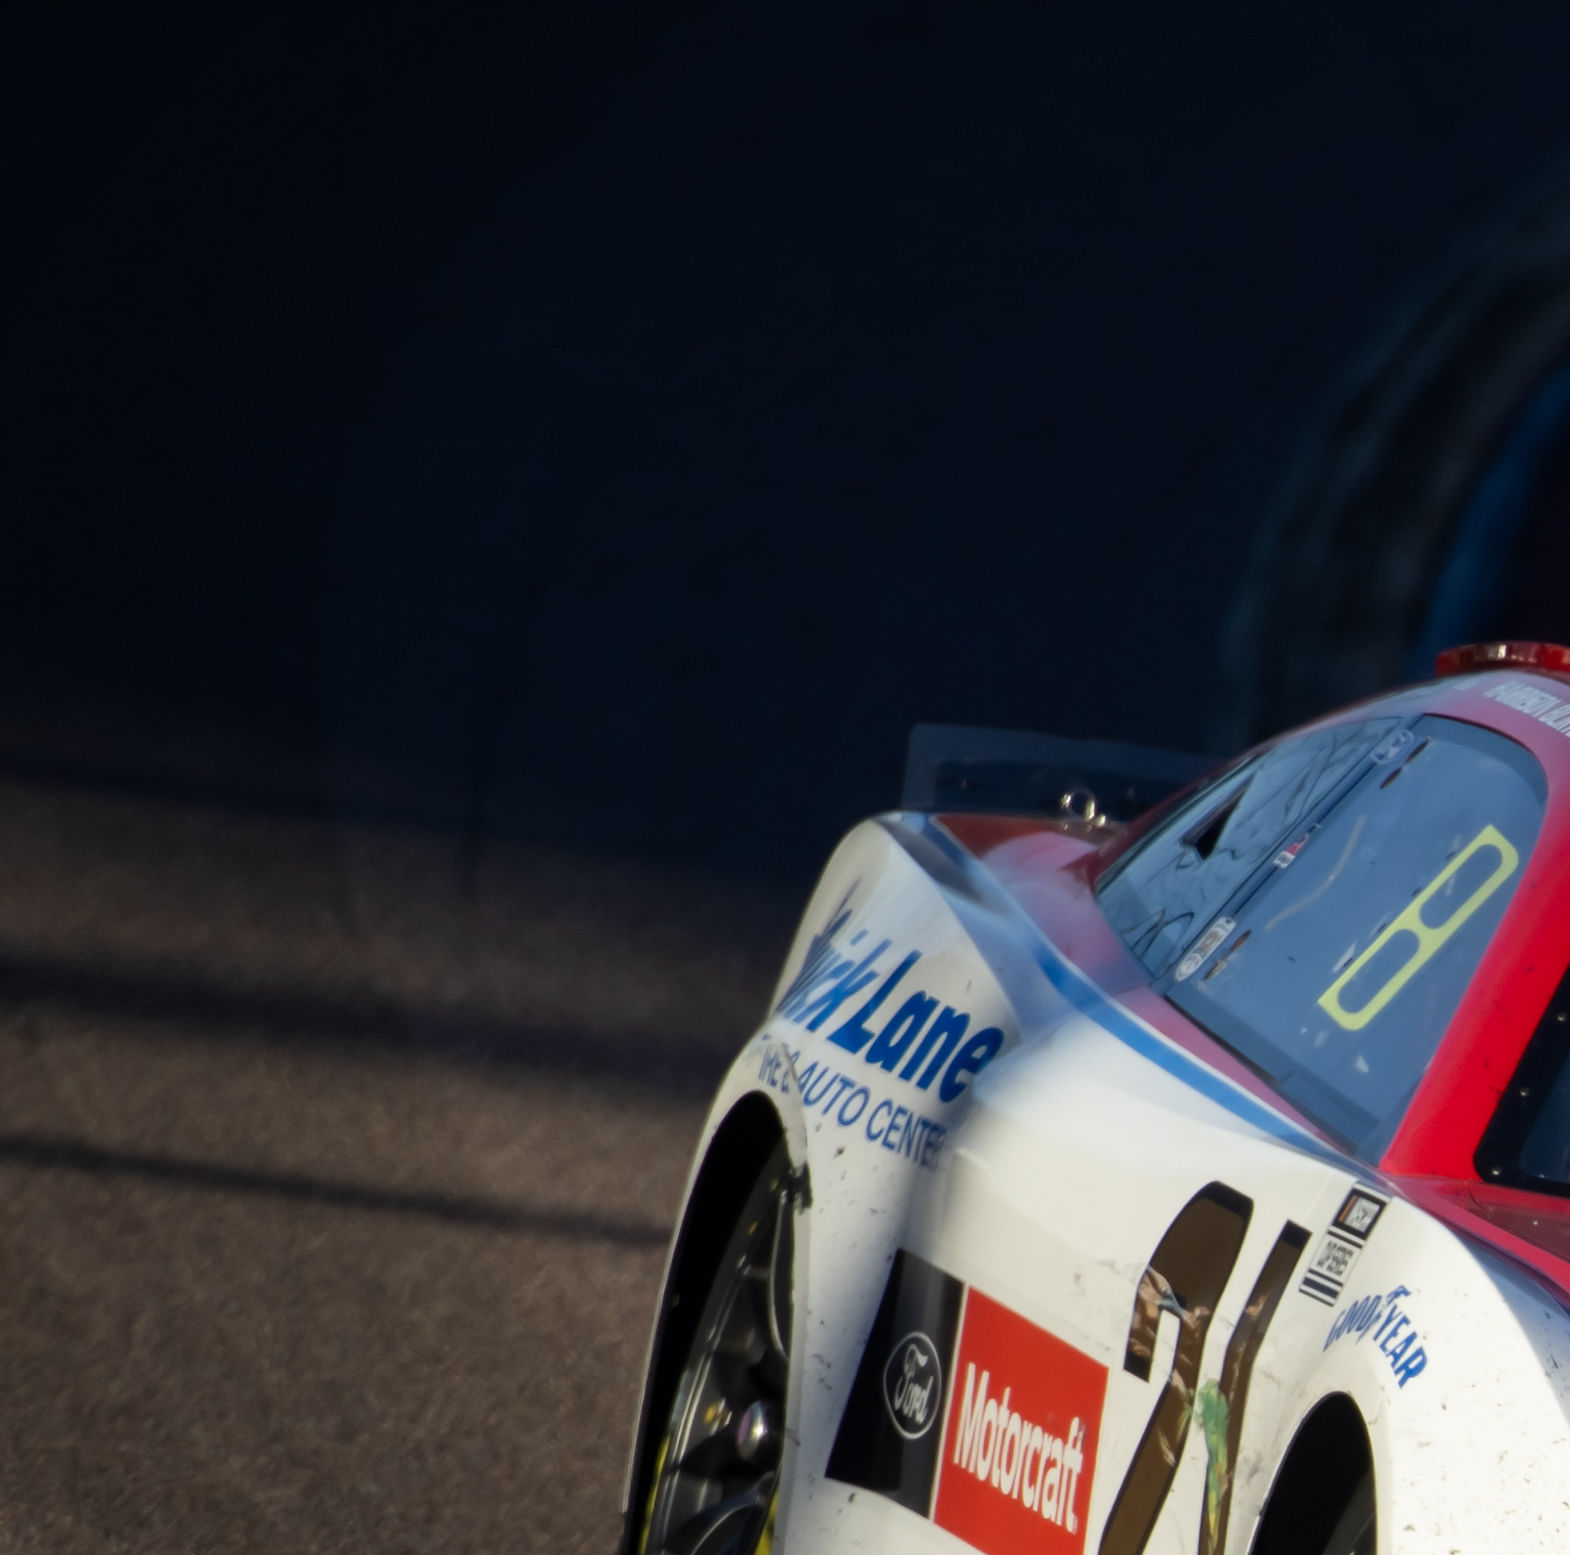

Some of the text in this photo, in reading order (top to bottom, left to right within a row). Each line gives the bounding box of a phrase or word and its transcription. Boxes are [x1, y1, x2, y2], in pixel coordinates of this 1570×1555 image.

[827, 950, 1004, 1104] Lane
[796, 1059, 872, 1127] AUTO
[894, 1342, 935, 1425] Ford
[953, 1363, 1084, 1533] Motorcraft
